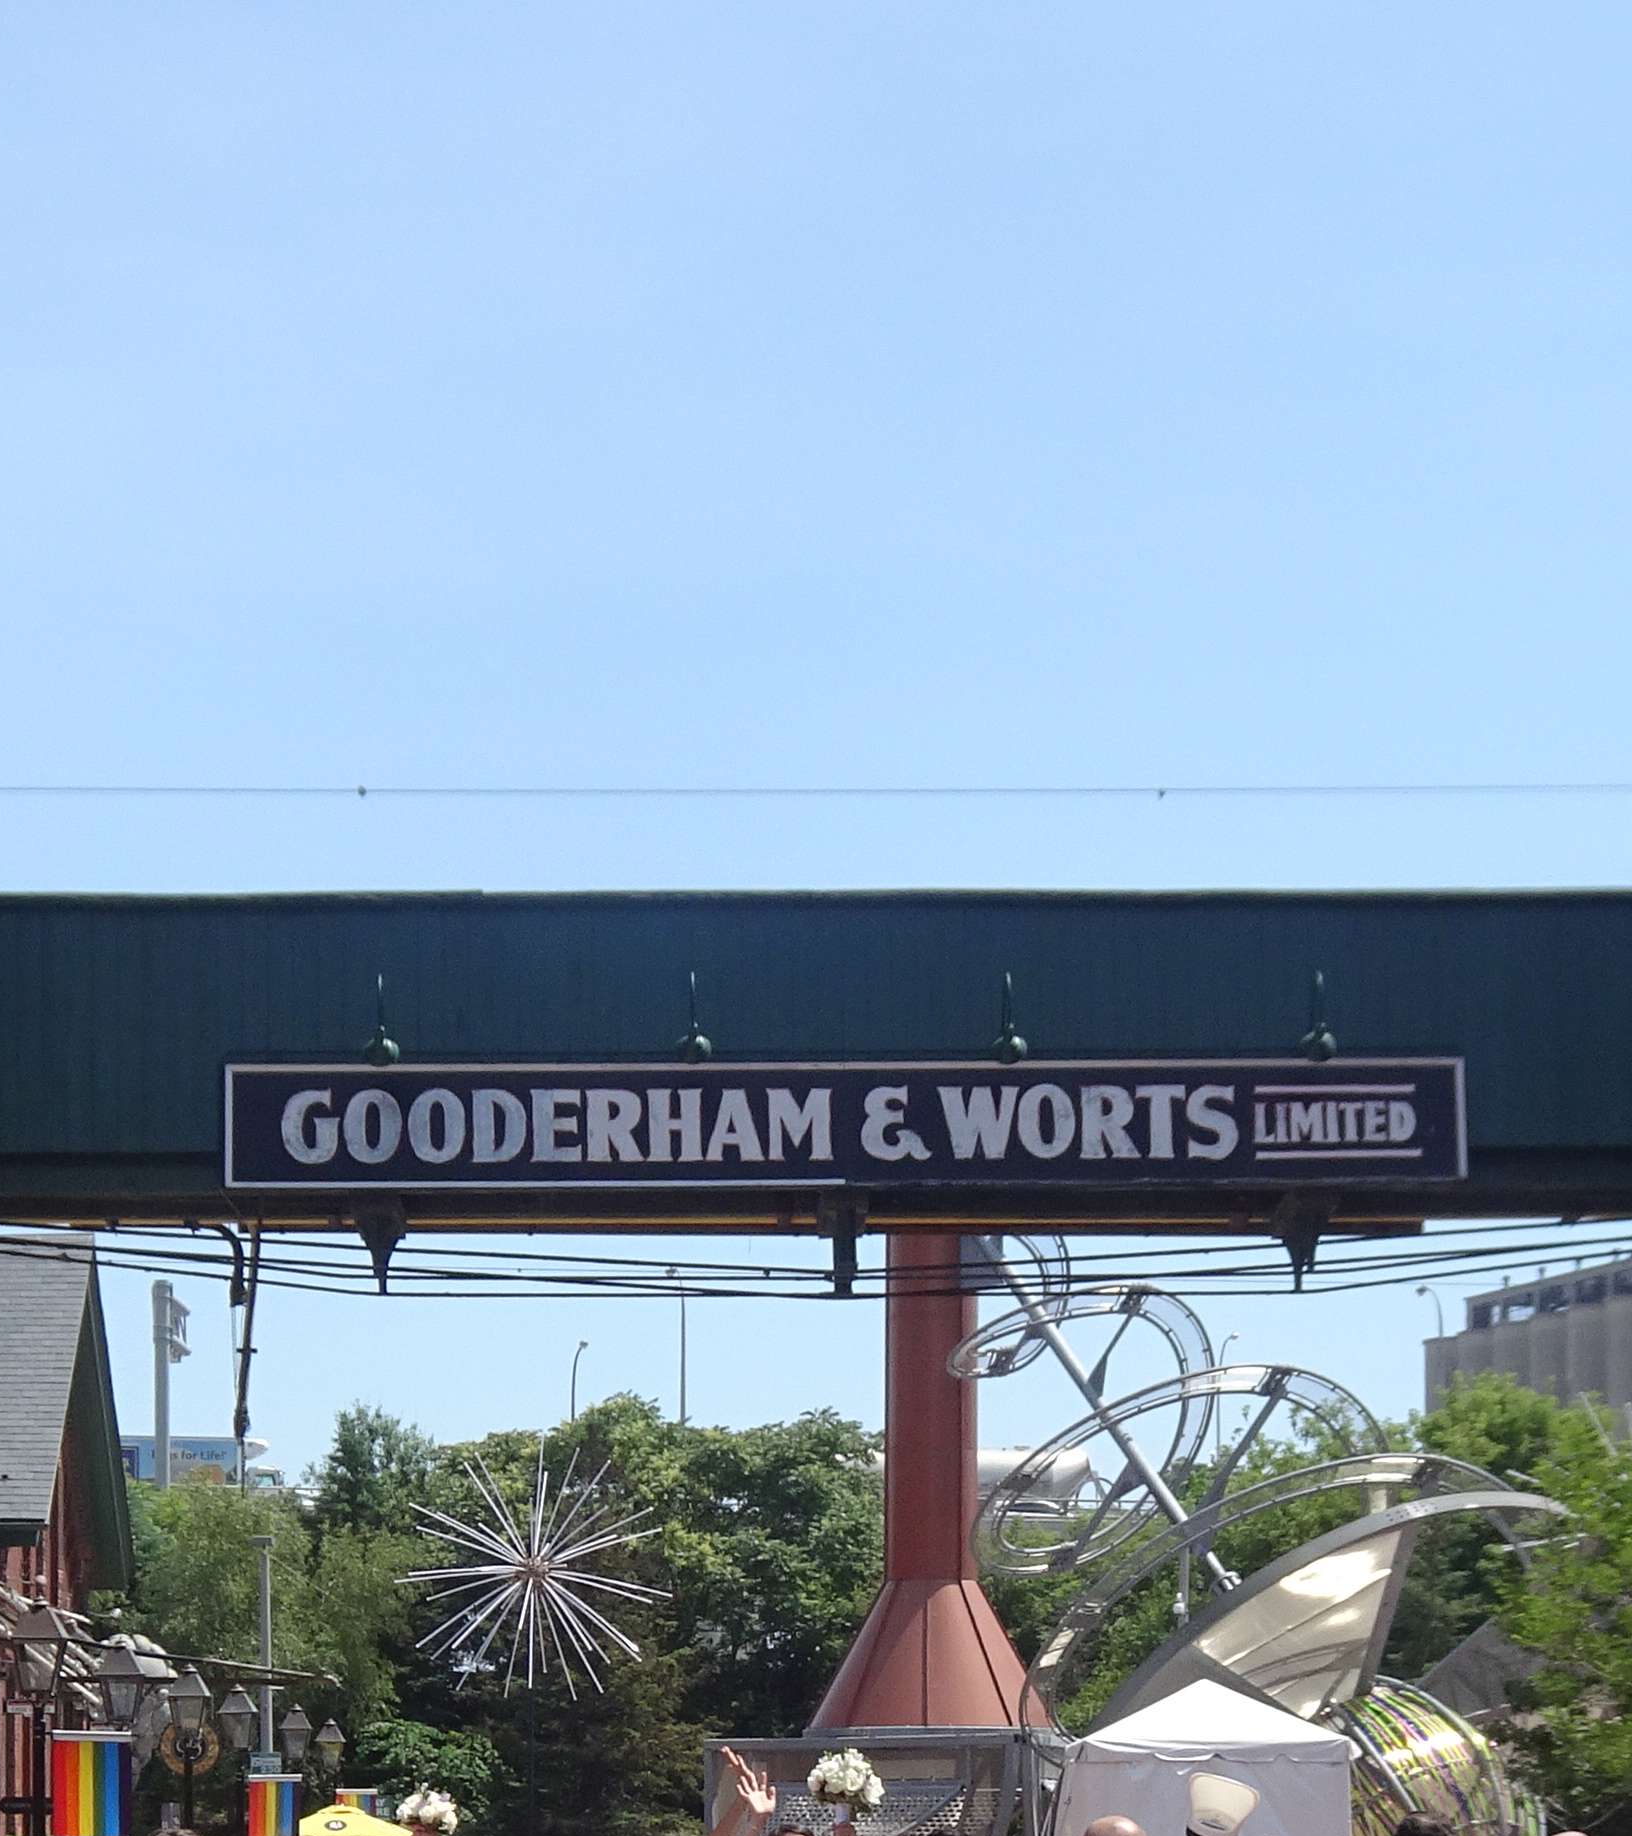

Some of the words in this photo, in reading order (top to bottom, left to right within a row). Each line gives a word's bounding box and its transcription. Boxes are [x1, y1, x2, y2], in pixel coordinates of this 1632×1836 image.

[279, 1086, 835, 1165] GOODERHAM
[860, 1084, 933, 1161] &
[937, 1082, 1240, 1161] WORTS
[1254, 1101, 1417, 1144] LIMITED
